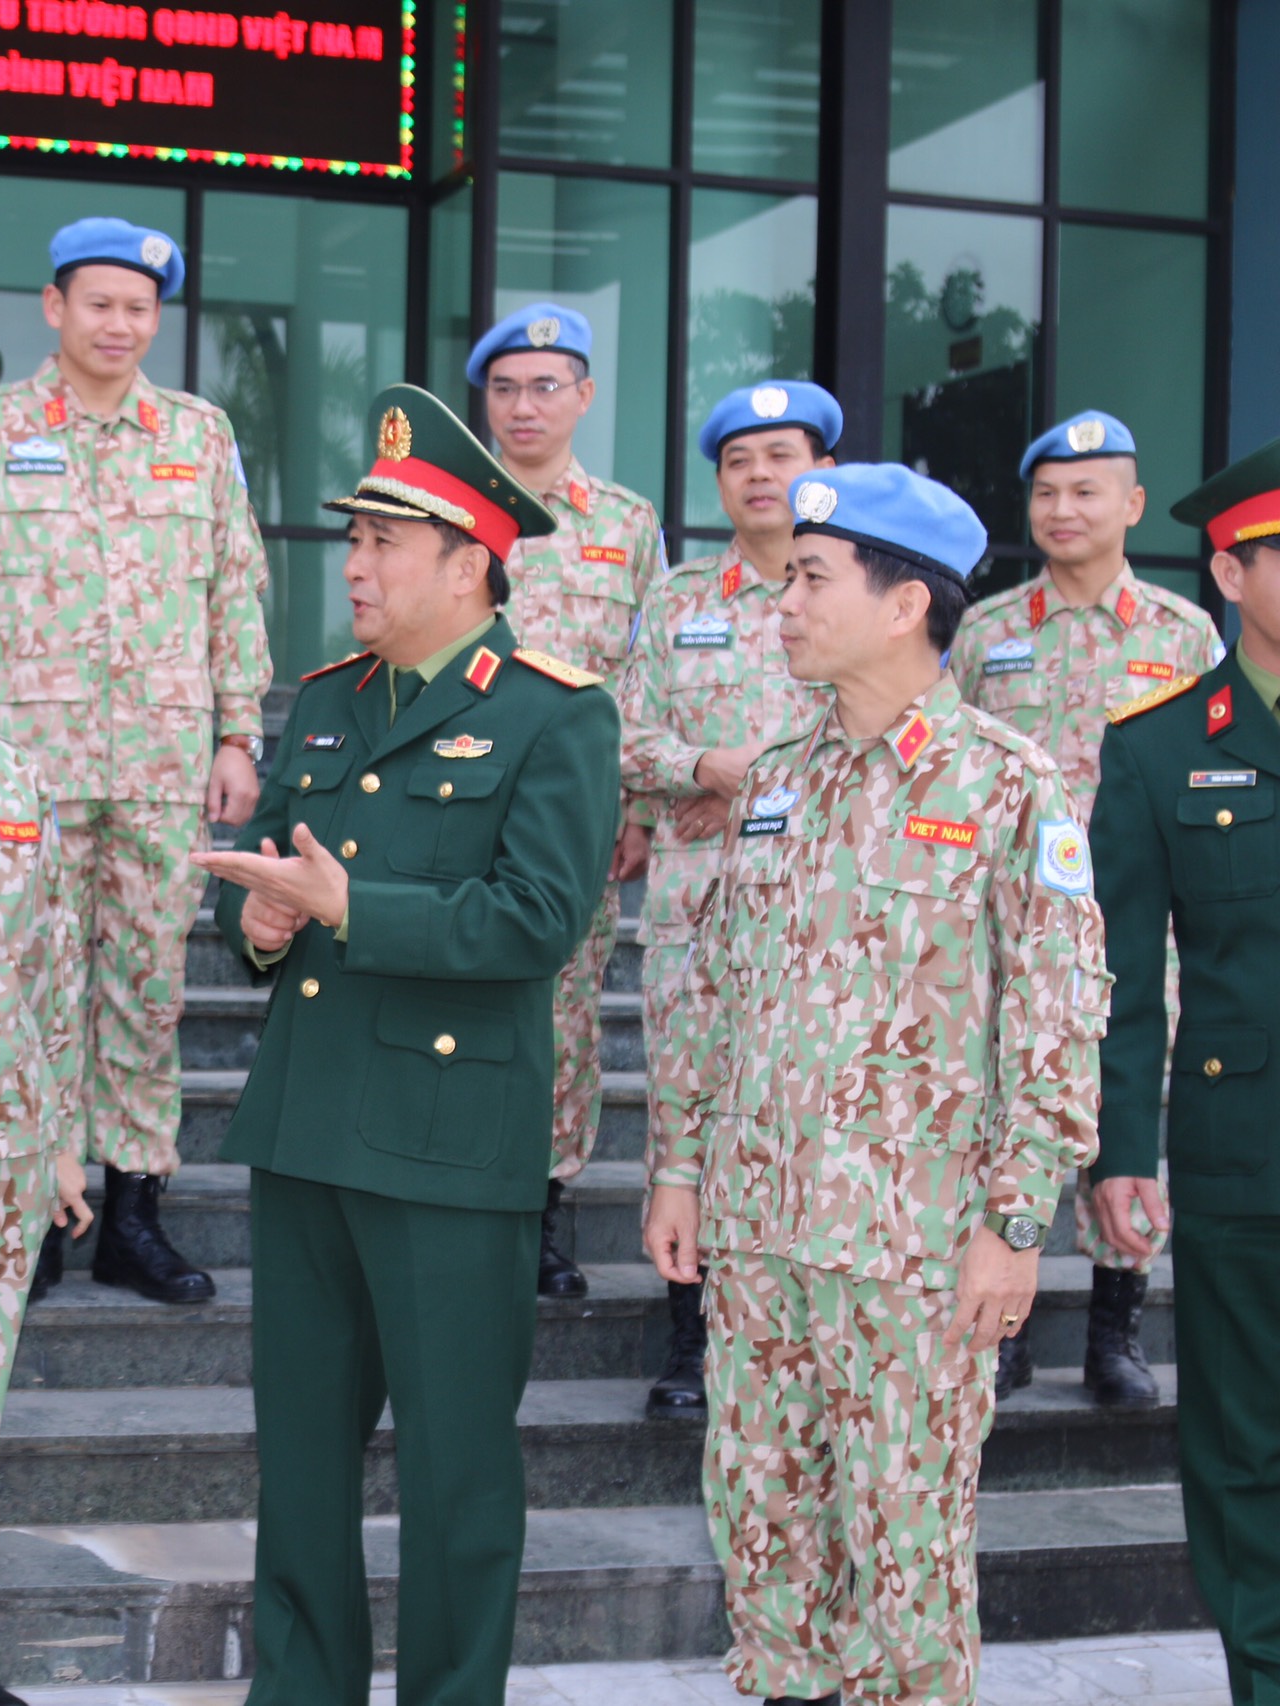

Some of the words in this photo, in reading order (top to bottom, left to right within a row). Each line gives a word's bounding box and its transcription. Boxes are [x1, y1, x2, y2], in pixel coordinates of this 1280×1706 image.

[240, 11, 309, 60] VIỆT
[310, 21, 383, 61] NAM
[67, 57, 138, 107] VIỆT
[138, 67, 214, 107] NAM
[910, 821, 937, 837] VIET
[941, 826, 973, 844] NAM
